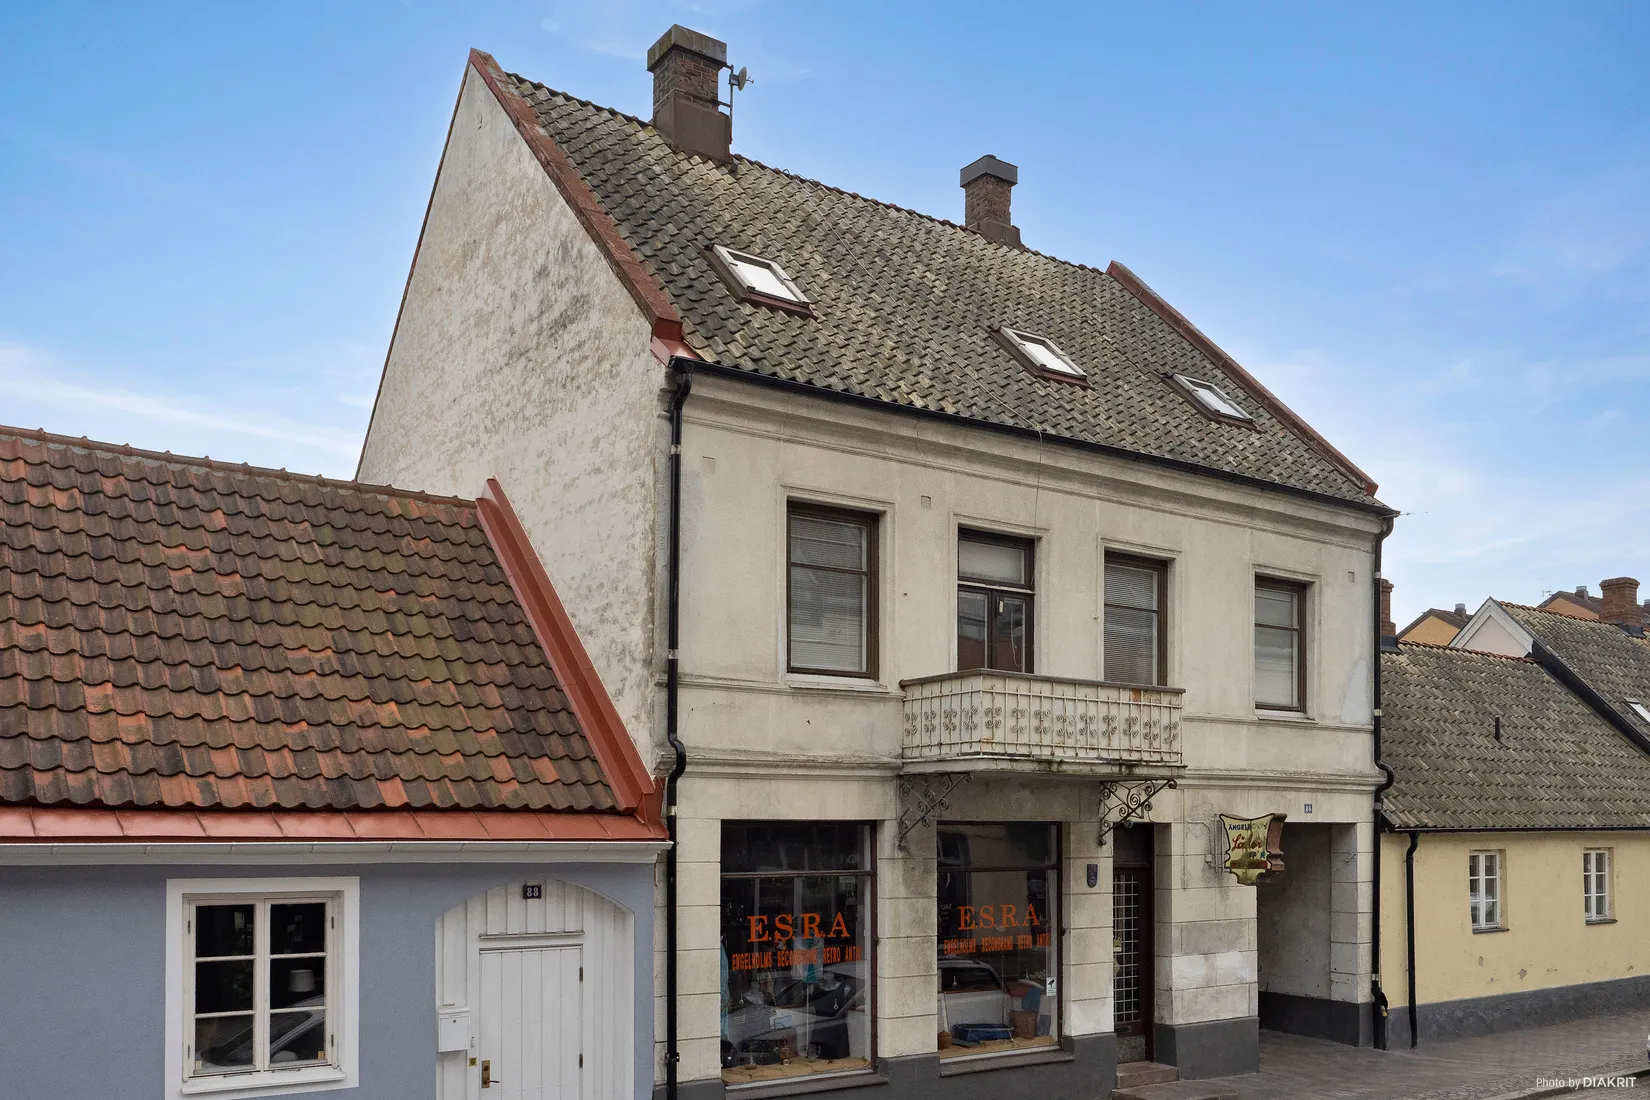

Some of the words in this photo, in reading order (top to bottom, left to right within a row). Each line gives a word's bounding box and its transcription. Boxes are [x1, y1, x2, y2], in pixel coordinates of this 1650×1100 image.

[526, 886, 539, 897] 88
[747, 912, 850, 943] E.S.R.A
[732, 951, 772, 971] ENGELHOLMS
[823, 946, 841, 964] RETRO
